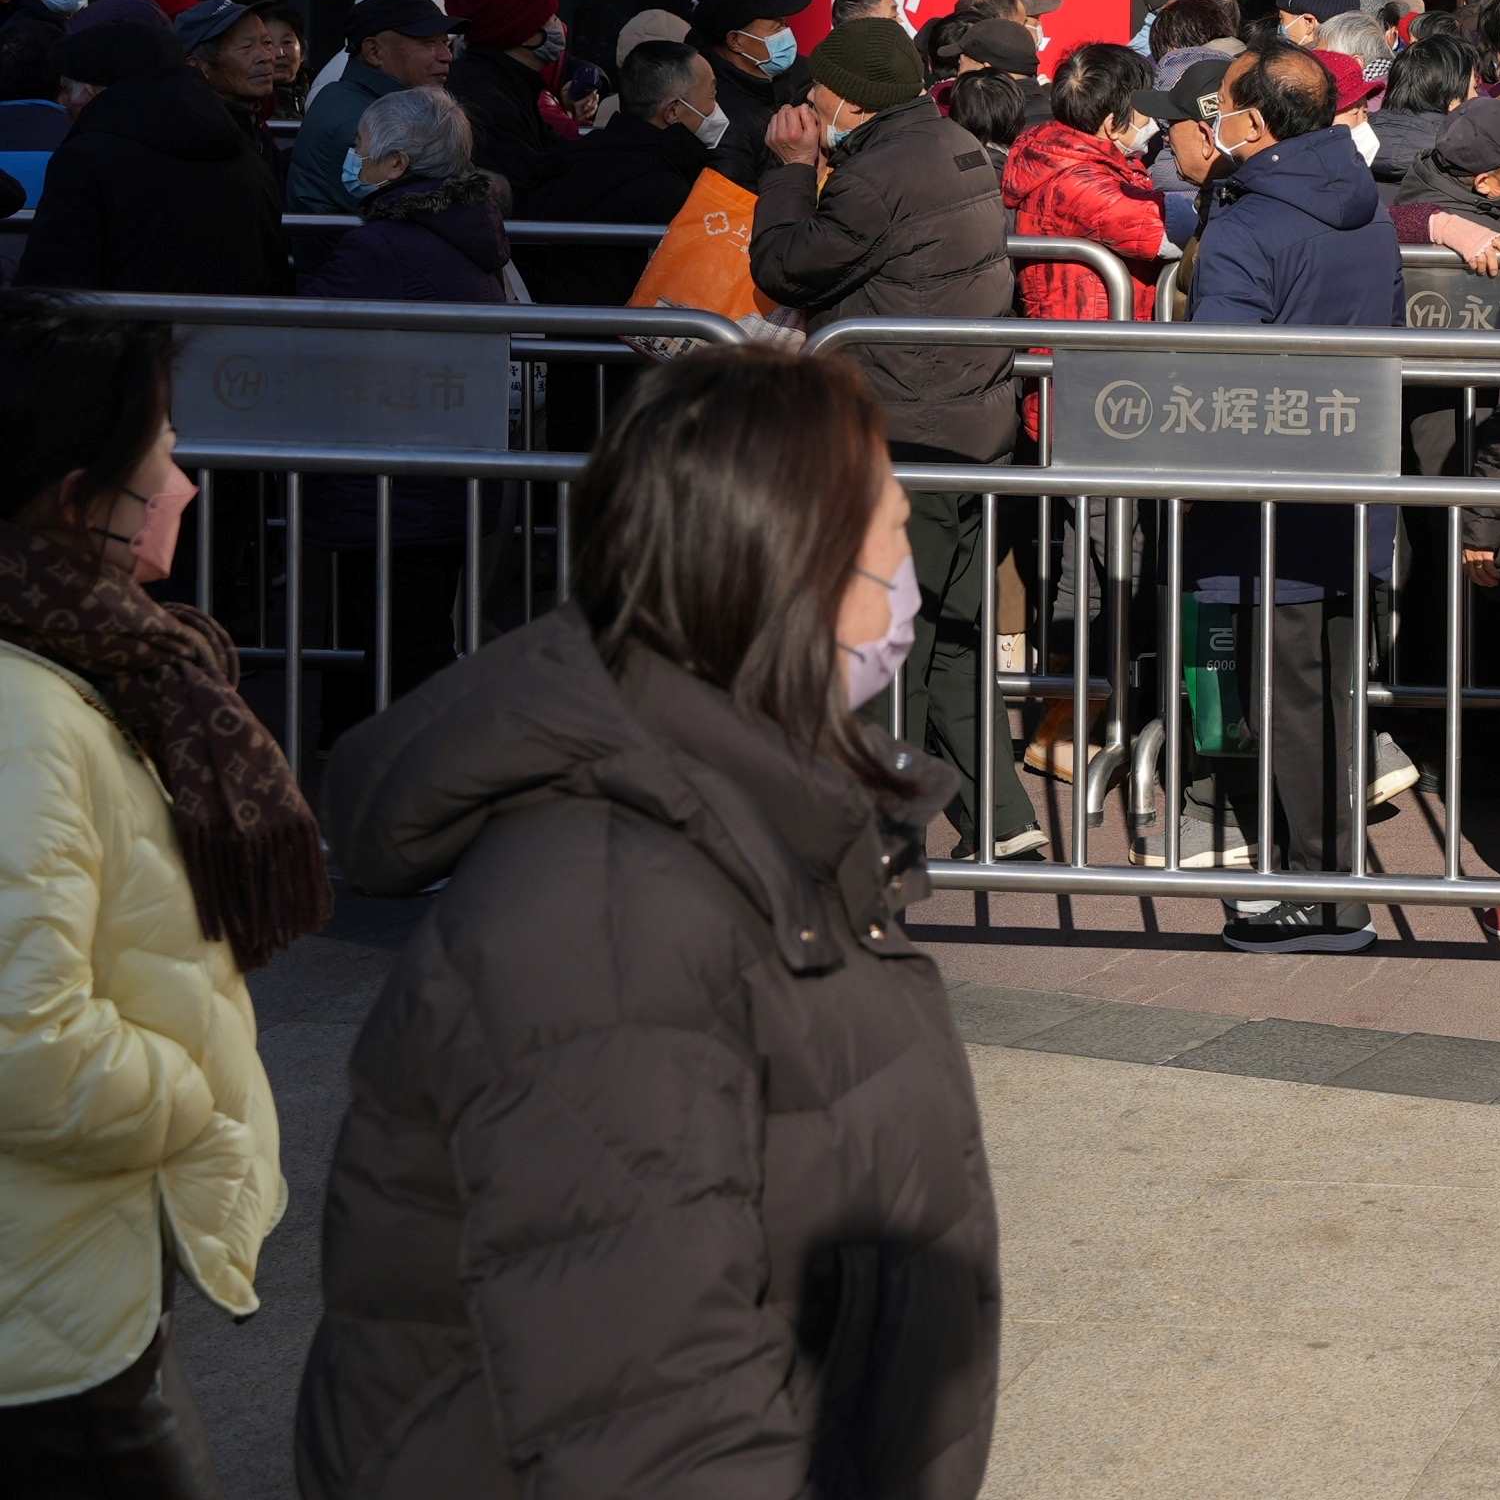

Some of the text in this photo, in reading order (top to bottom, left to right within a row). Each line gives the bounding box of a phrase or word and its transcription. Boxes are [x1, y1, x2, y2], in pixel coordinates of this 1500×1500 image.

[1160, 387, 1361, 438] 永辉超市
[1207, 660, 1236, 671] 6000
